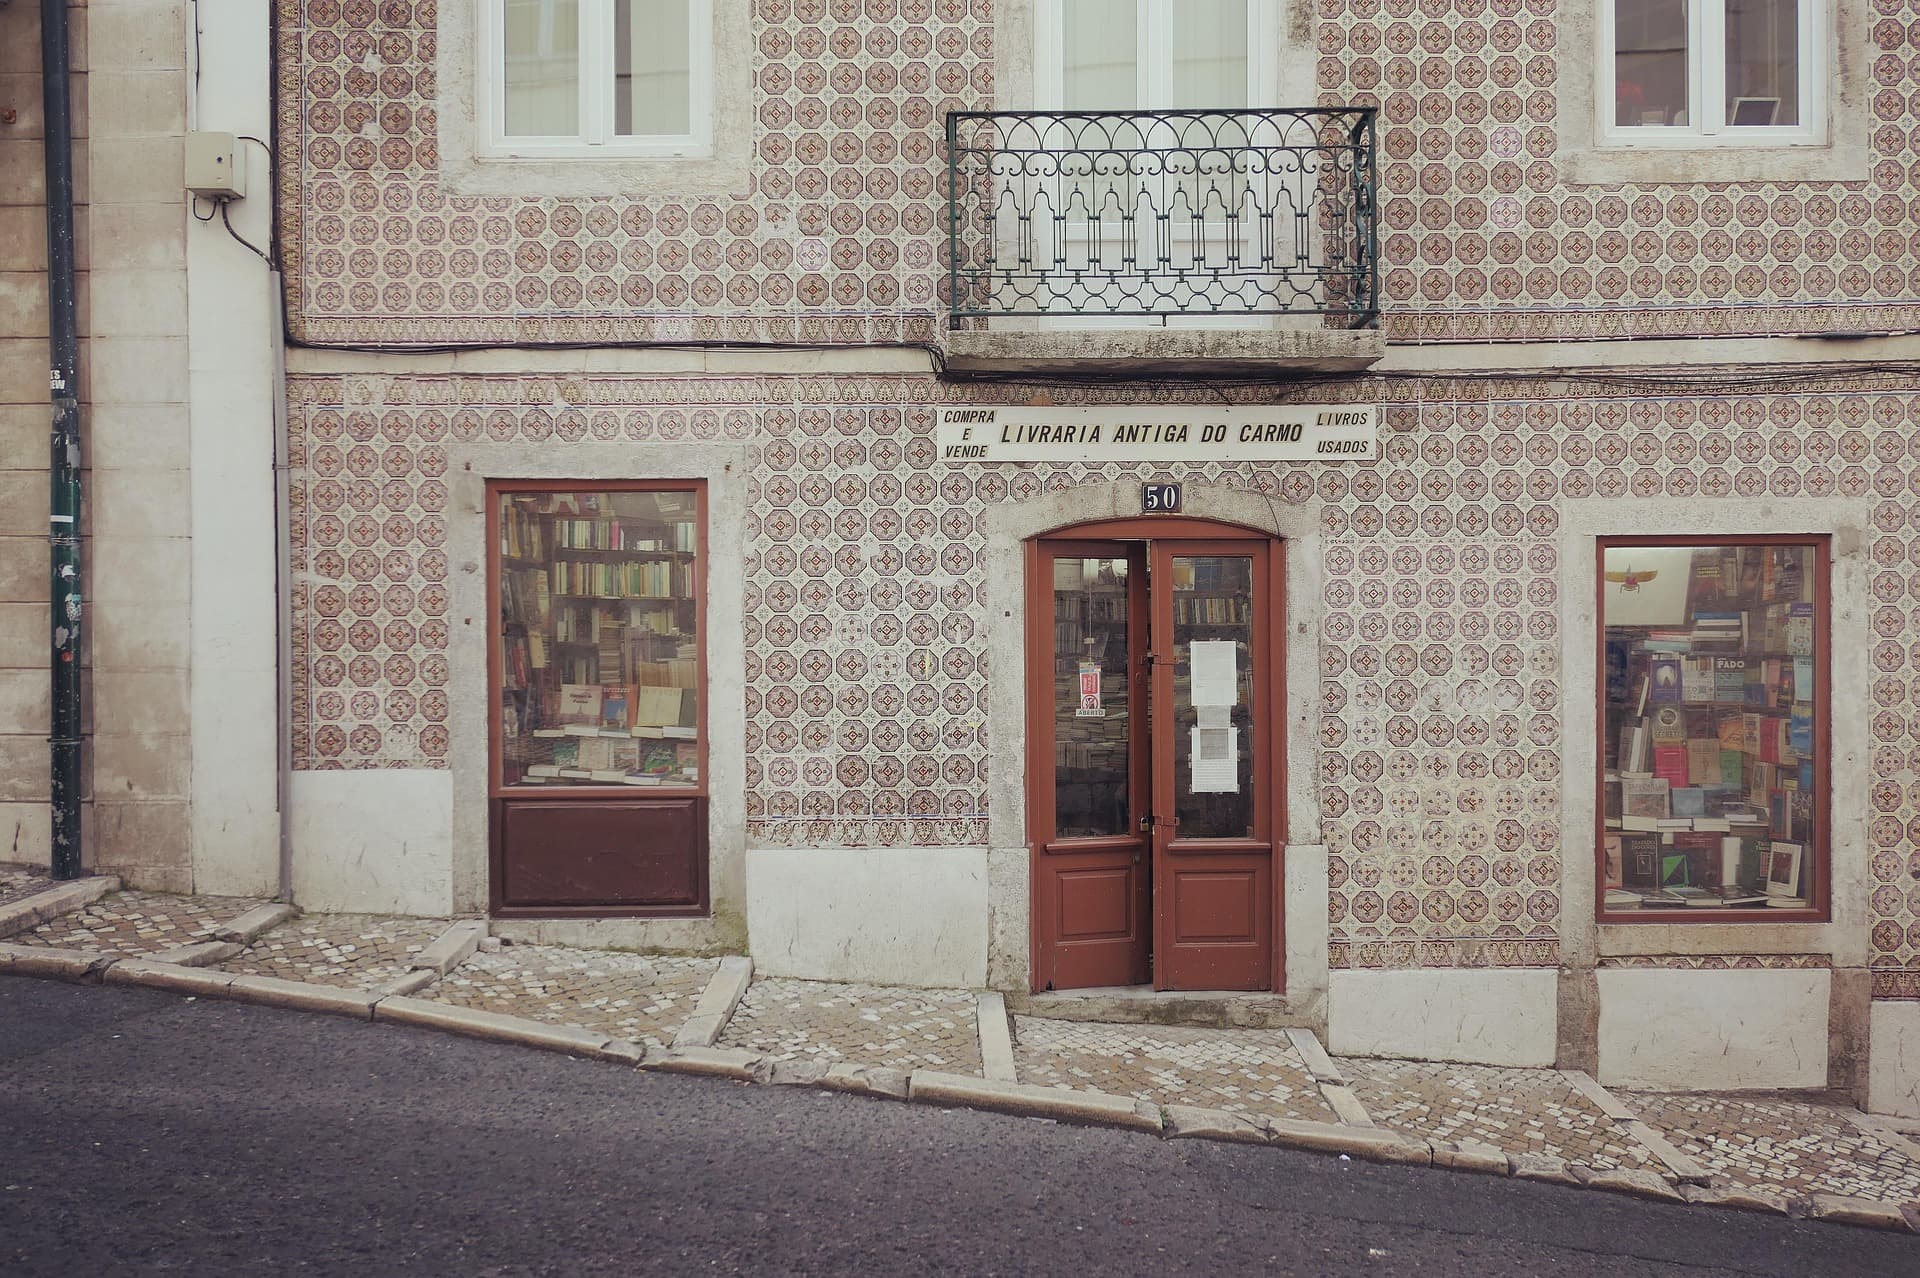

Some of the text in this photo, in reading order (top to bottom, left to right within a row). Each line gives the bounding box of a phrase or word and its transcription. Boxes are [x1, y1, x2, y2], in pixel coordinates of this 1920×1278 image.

[944, 410, 995, 423] COMPRA
[1317, 412, 1368, 426] LIVROS
[962, 428, 971, 440] E
[1000, 424, 1303, 443] LIVRARIA ANTIGA DO CARMO
[945, 445, 988, 458] VENDE
[1317, 440, 1369, 453] USADOS
[1147, 486, 1176, 509] 50
[1717, 661, 1745, 669] FADO
